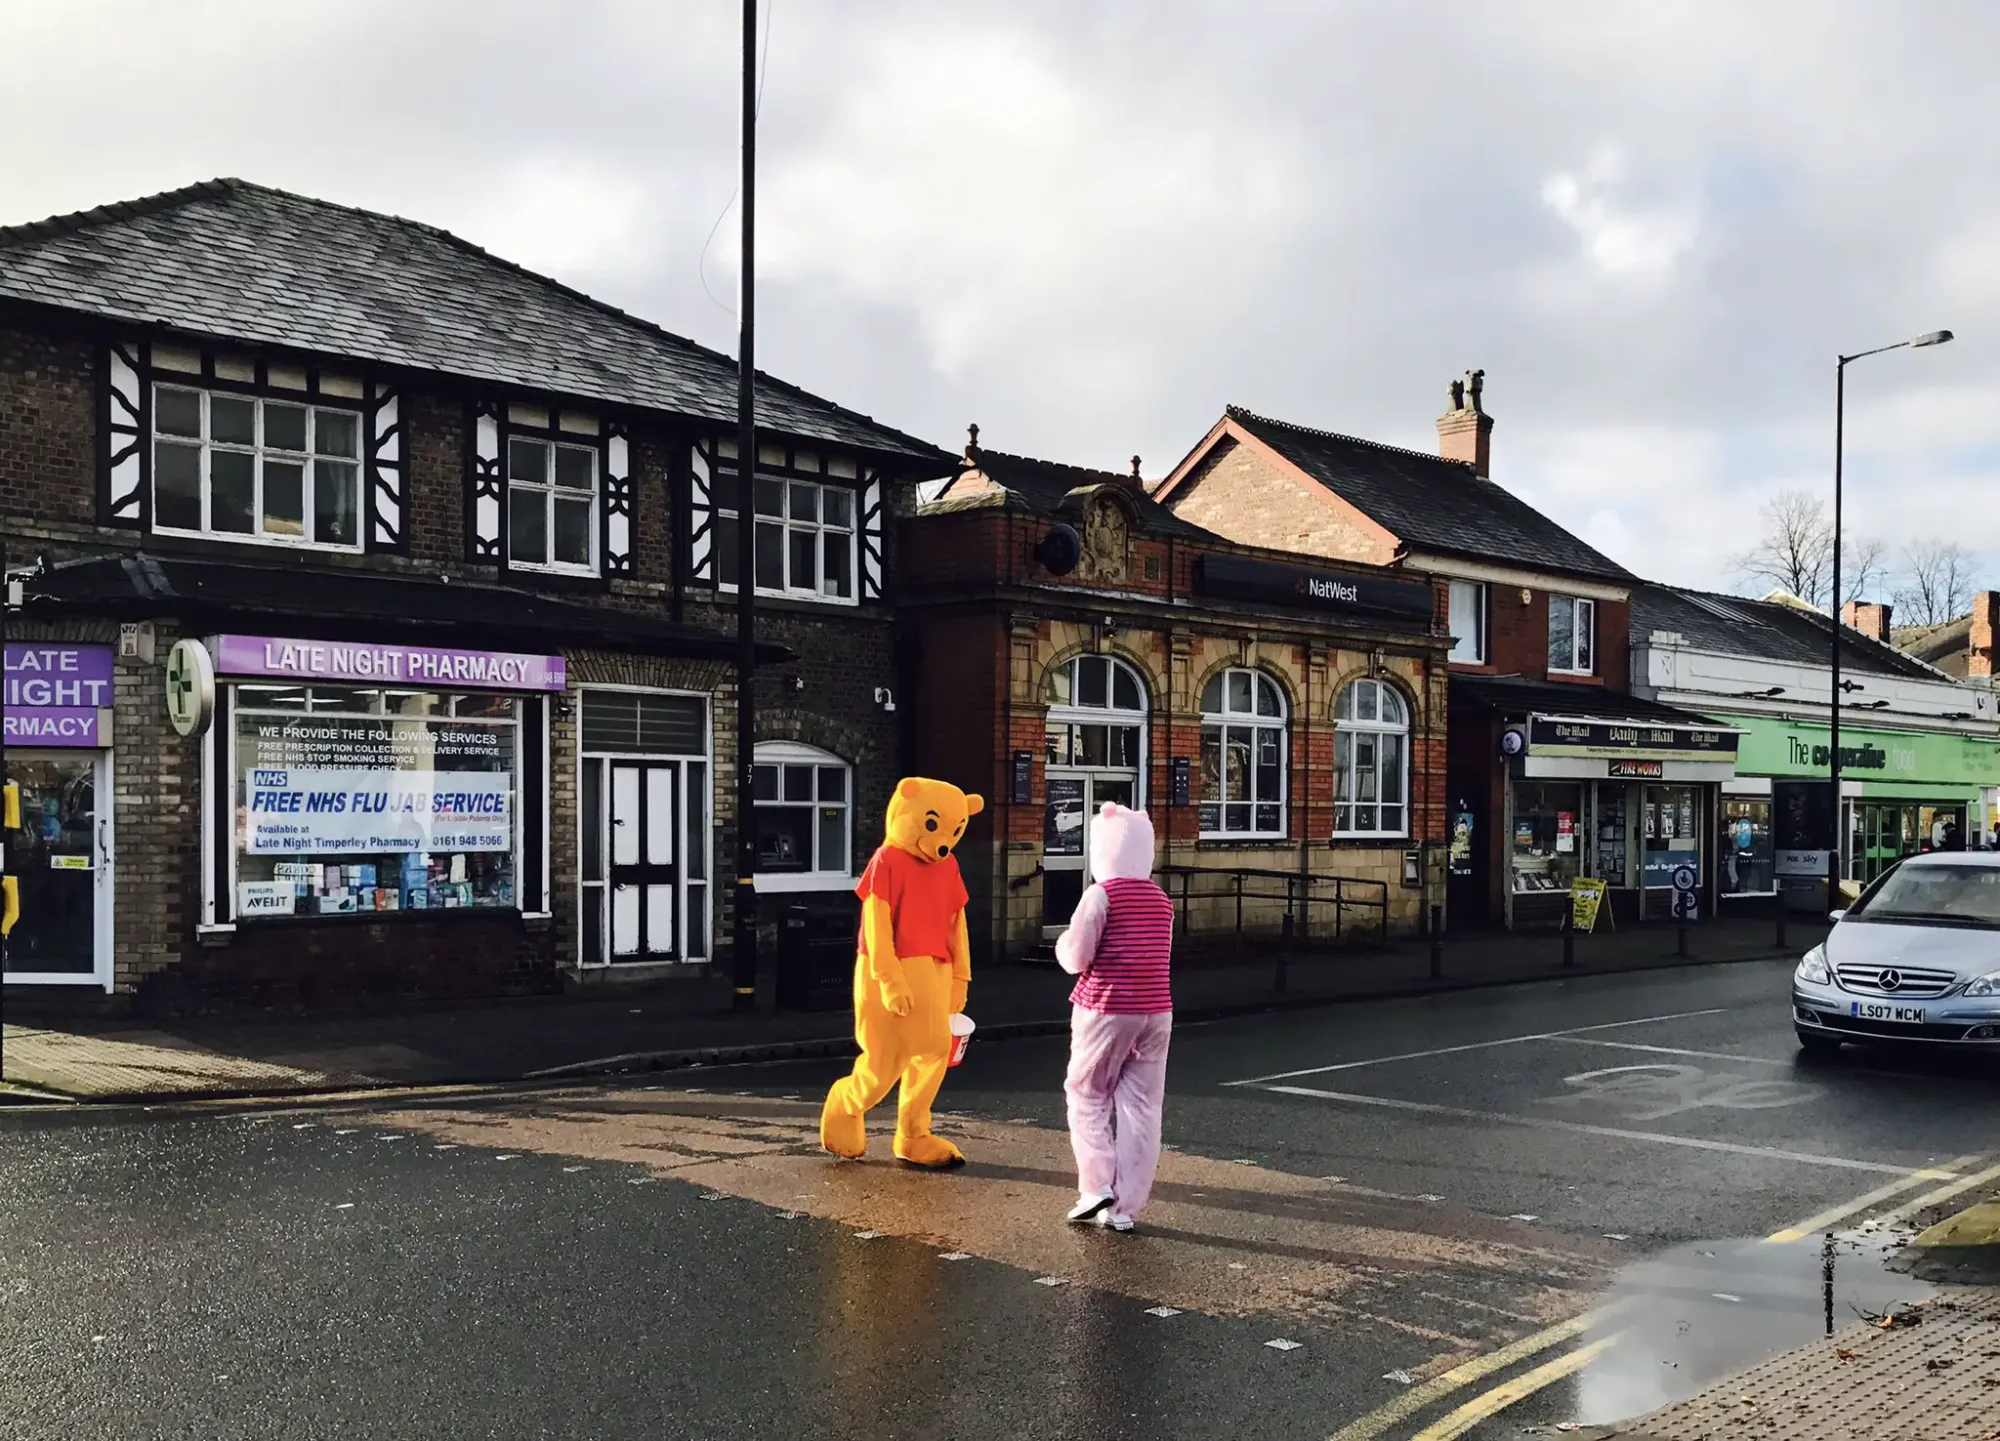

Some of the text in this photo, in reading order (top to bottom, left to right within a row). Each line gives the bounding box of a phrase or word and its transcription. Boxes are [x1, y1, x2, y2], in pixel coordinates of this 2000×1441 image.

[1309, 578, 1358, 602] NatWest
[4, 650, 79, 672] LATE
[265, 643, 325, 673] LATE
[331, 647, 402, 676] NIGHT
[407, 652, 529, 683] PHARMACY
[4, 679, 107, 706] IGHT
[259, 726, 498, 745] WE PROVIDE THE FOLLOWING SERVICES
[1557, 724, 1590, 737] The Mail
[1609, 728, 1674, 746] Daily Mail
[258, 742, 283, 751] FREE
[285, 743, 353, 753] PRESCRIPTION
[354, 744, 411, 754] COLLECTION
[421, 746, 463, 755] DELIVERY
[464, 747, 500, 756] SERVICE
[1787, 736, 1809, 765] The
[258, 752, 415, 764] FREE NHS STOP SMOKING SERVICE
[255, 771, 287, 786] NHS
[252, 791, 505, 813] FREE NHS FLU JAB SERVICE
[257, 824, 310, 834] Available at
[255, 835, 503, 850] Late Night Timperley Pharmacy 0161 948 5066
[247, 887, 274, 895] PHILIPS
[1859, 1004, 1891, 1018] LS07
